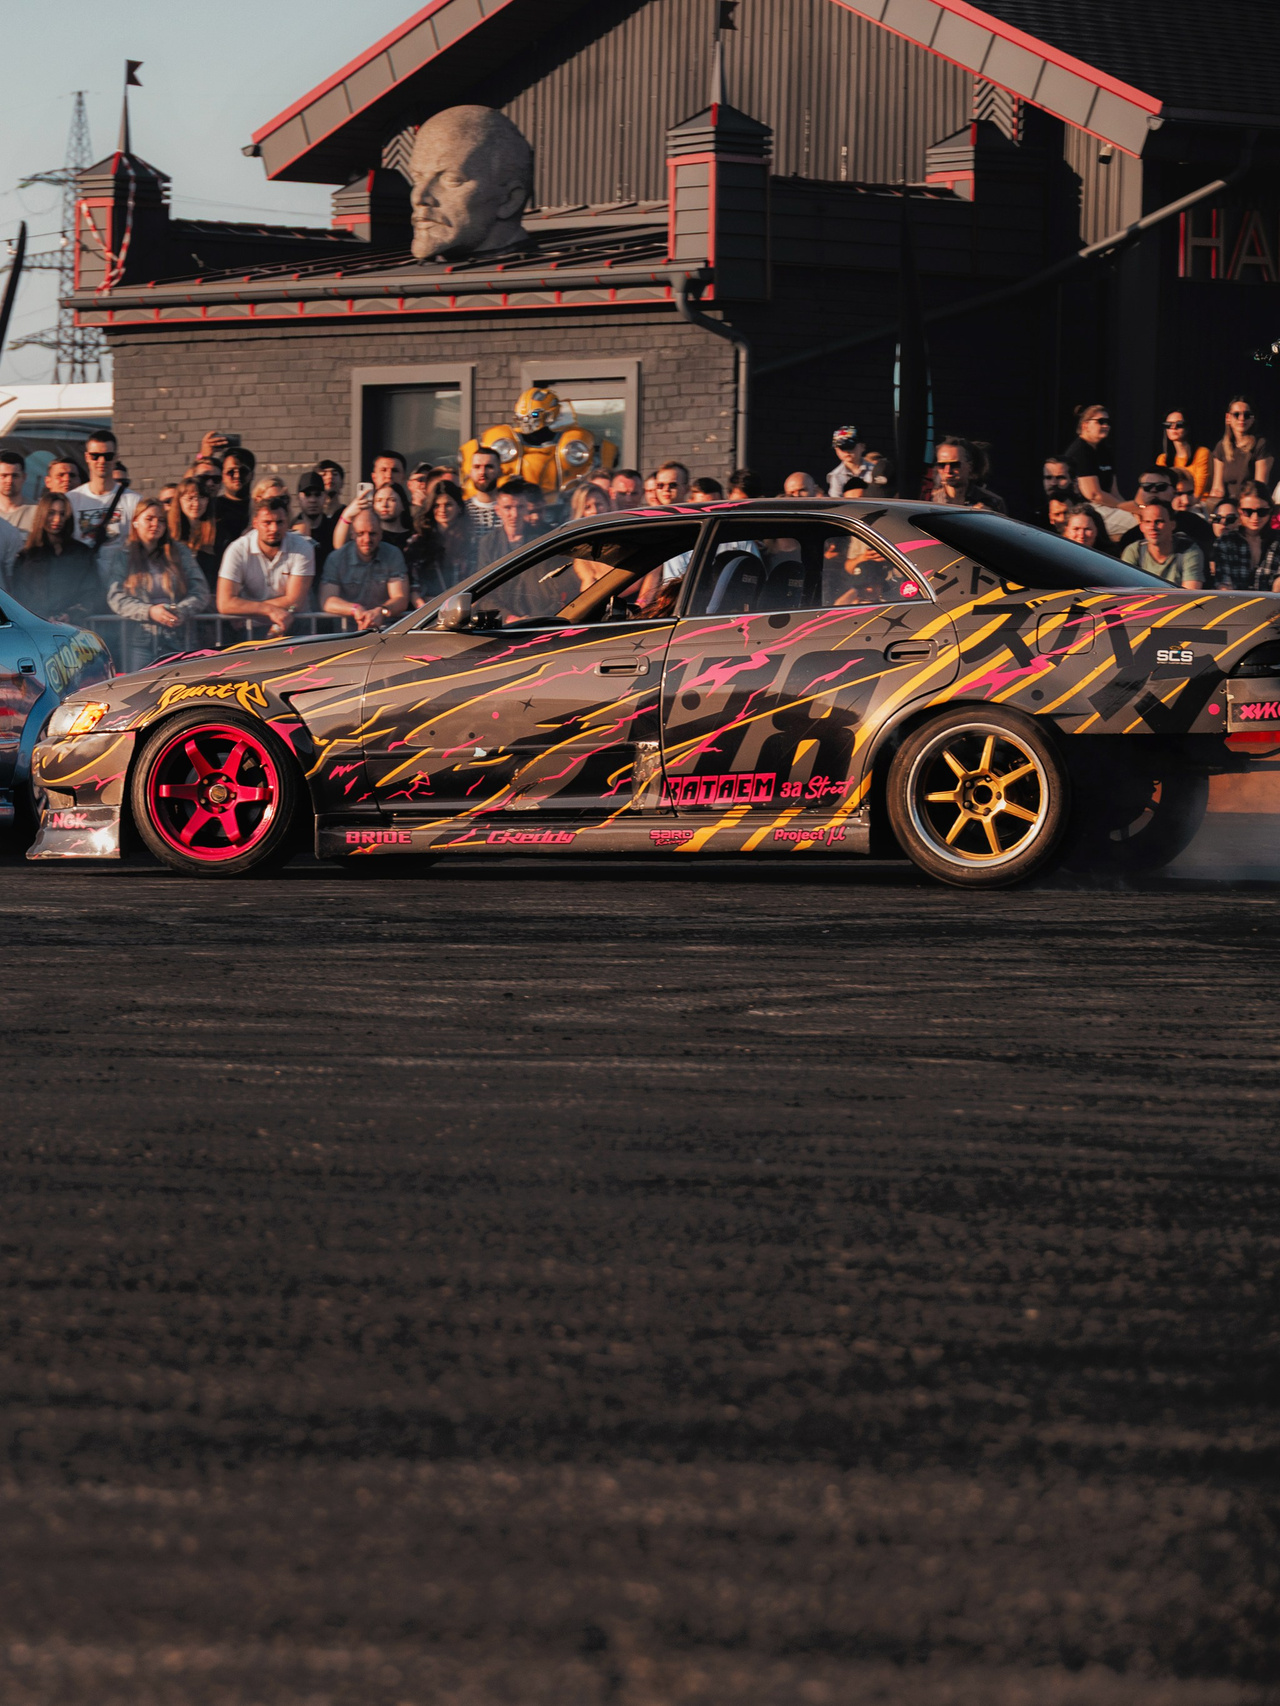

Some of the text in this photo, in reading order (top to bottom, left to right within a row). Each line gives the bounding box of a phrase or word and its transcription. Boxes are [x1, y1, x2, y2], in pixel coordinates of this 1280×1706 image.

[1179, 208, 1280, 281] HA
[1157, 650, 1194, 662] SCS
[1239, 701, 1280, 720] ХИК
[804, 776, 854, 799] Street
[52, 813, 87, 829] NGK
[345, 831, 413, 844] BRIDE
[774, 828, 824, 843] Project
